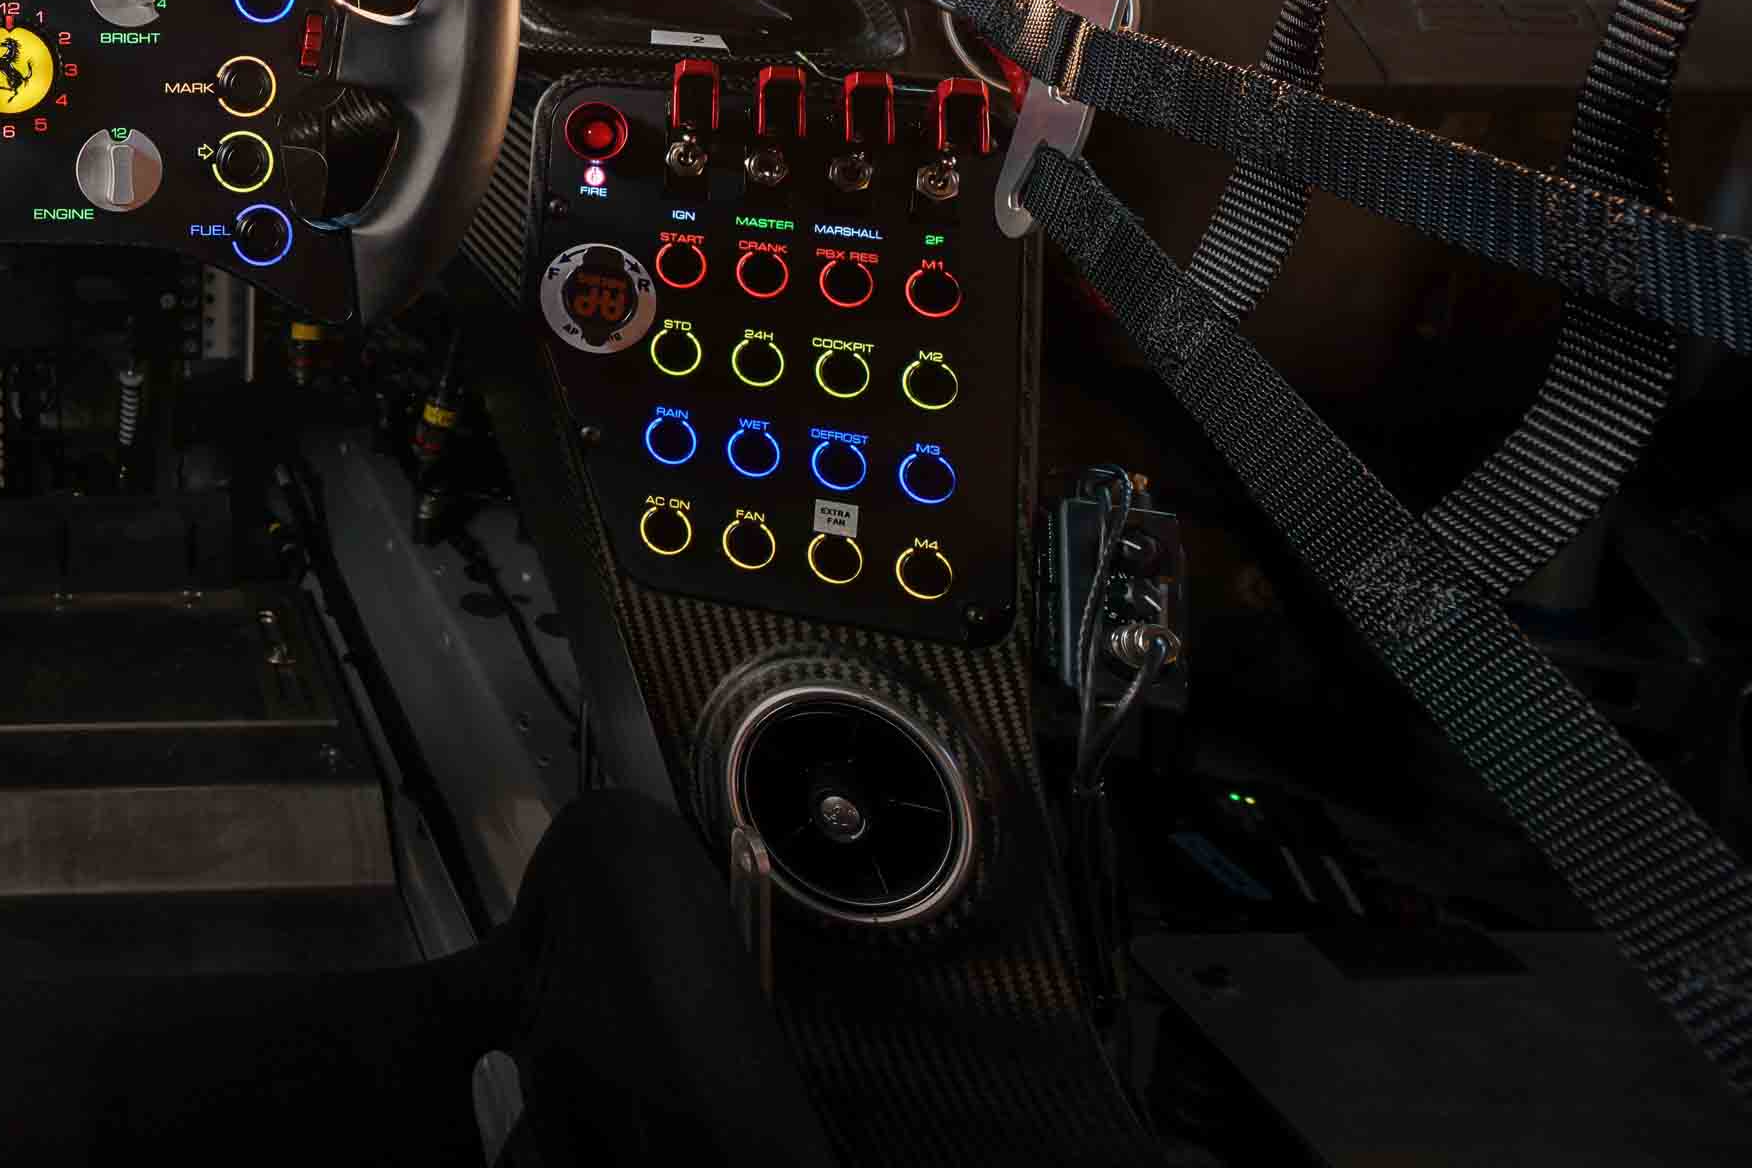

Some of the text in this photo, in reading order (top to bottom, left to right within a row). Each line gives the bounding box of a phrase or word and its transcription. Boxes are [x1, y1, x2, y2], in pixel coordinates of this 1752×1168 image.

[0, 2, 21, 15] 12
[36, 11, 43, 23] 1
[59, 32, 71, 44] 2
[100, 32, 161, 44] BRIGHT
[692, 36, 705, 44] 2
[65, 64, 78, 76] 3
[165, 82, 214, 94] MARK
[56, 95, 68, 106] 4
[35, 118, 47, 131] 5
[3, 125, 16, 138] 6
[111, 127, 127, 139] 12
[580, 185, 608, 197] FIRE
[33, 208, 94, 220] ENGINE
[672, 209, 696, 221] IGN
[736, 216, 794, 231] MASTER
[190, 224, 231, 237] FUEL
[814, 223, 884, 240] MARSHALL
[660, 231, 705, 244] START
[924, 234, 945, 246] 2F
[738, 239, 788, 254] CRANK
[816, 247, 879, 264] PBX RES
[921, 259, 944, 271] M1
[663, 319, 691, 331] STD
[744, 329, 774, 341] 24H
[812, 336, 875, 353] COCKPIT
[919, 350, 944, 363] M2
[656, 406, 689, 420] RAIN
[739, 418, 770, 432] WET
[811, 429, 869, 446] DEFROST
[916, 443, 940, 456] M3
[646, 495, 690, 511] AC ON
[735, 509, 765, 522] FAN
[820, 506, 851, 519] EXTRA
[827, 517, 846, 526] FAN
[915, 537, 938, 550] M4
